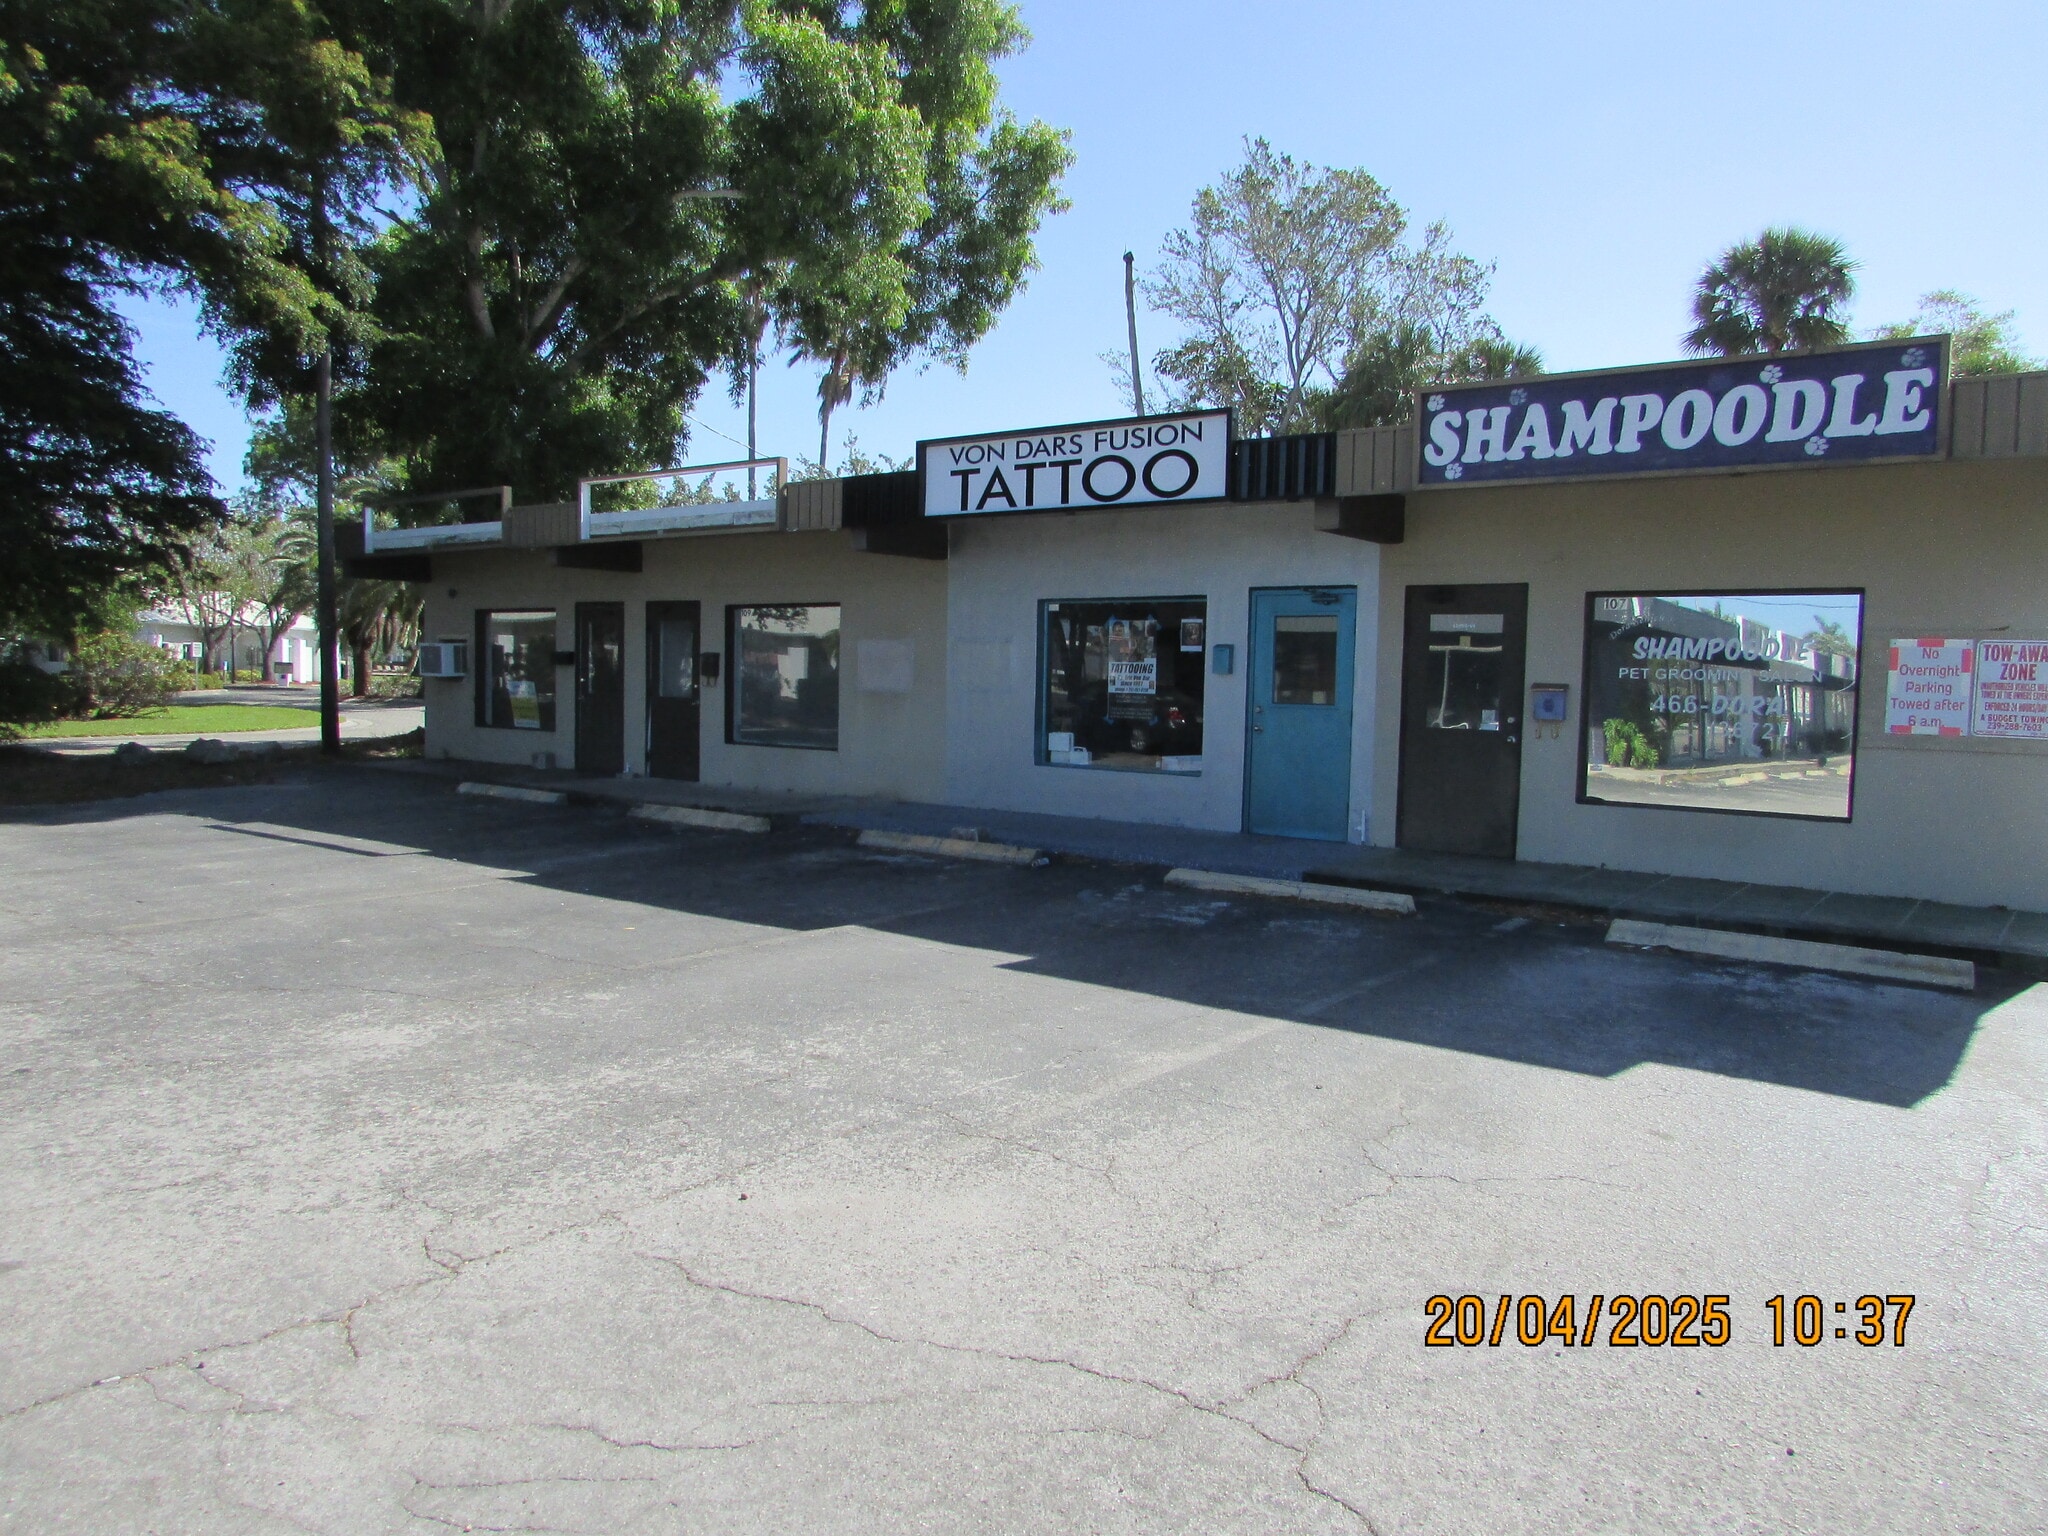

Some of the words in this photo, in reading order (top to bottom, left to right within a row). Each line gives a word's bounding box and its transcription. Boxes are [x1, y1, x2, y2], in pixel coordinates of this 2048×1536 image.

[1423, 367, 1934, 467] SHAMPOODLE
[950, 442, 1005, 465] VON
[1015, 434, 1083, 460] DARS
[1094, 421, 1203, 452] FUSION
[950, 449, 1199, 511] TATTOO
[1604, 598, 1627, 609] 107
[1632, 636, 1815, 661] SHAMPOODE
[1922, 647, 1940, 659] No
[1983, 644, 2048, 662] TOW-AWA
[1110, 663, 1154, 674] TATTOOING
[1618, 667, 1650, 680] PET
[1655, 668, 1750, 682] GROOMIN
[1899, 663, 1960, 679] Overnight
[2000, 663, 2037, 681] ZONE
[1905, 681, 1953, 696] Parking
[1890, 697, 1930, 710] Towed
[1934, 699, 1965, 711] after
[1908, 715, 1916, 726] 6
[1987, 714, 2018, 722] BUDGET
